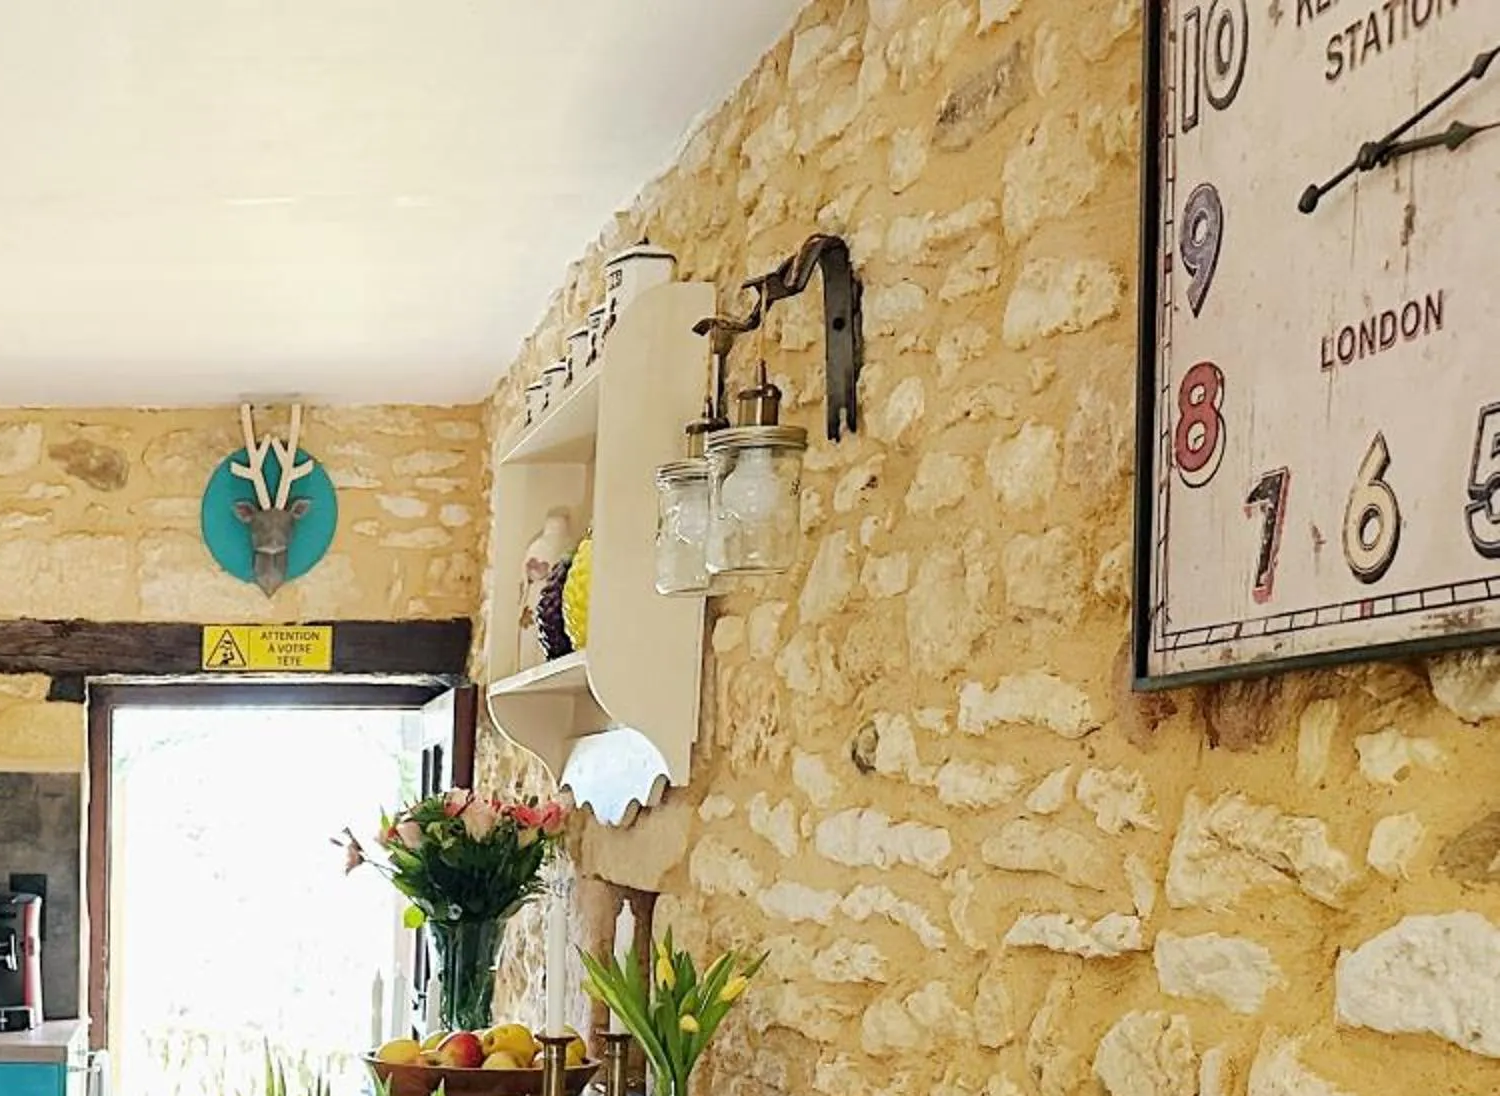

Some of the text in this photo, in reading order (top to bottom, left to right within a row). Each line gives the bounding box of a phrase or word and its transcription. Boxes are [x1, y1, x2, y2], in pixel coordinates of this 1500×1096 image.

[1181, 0, 1249, 134] 10
[1179, 182, 1224, 319] 9
[1320, 289, 1445, 371] LONDON
[1175, 361, 1227, 489] 8
[1243, 465, 1291, 605] 7
[1342, 430, 1401, 585] 6
[259, 631, 320, 641] ATTENTION
[277, 643, 313, 654] VOTRE
